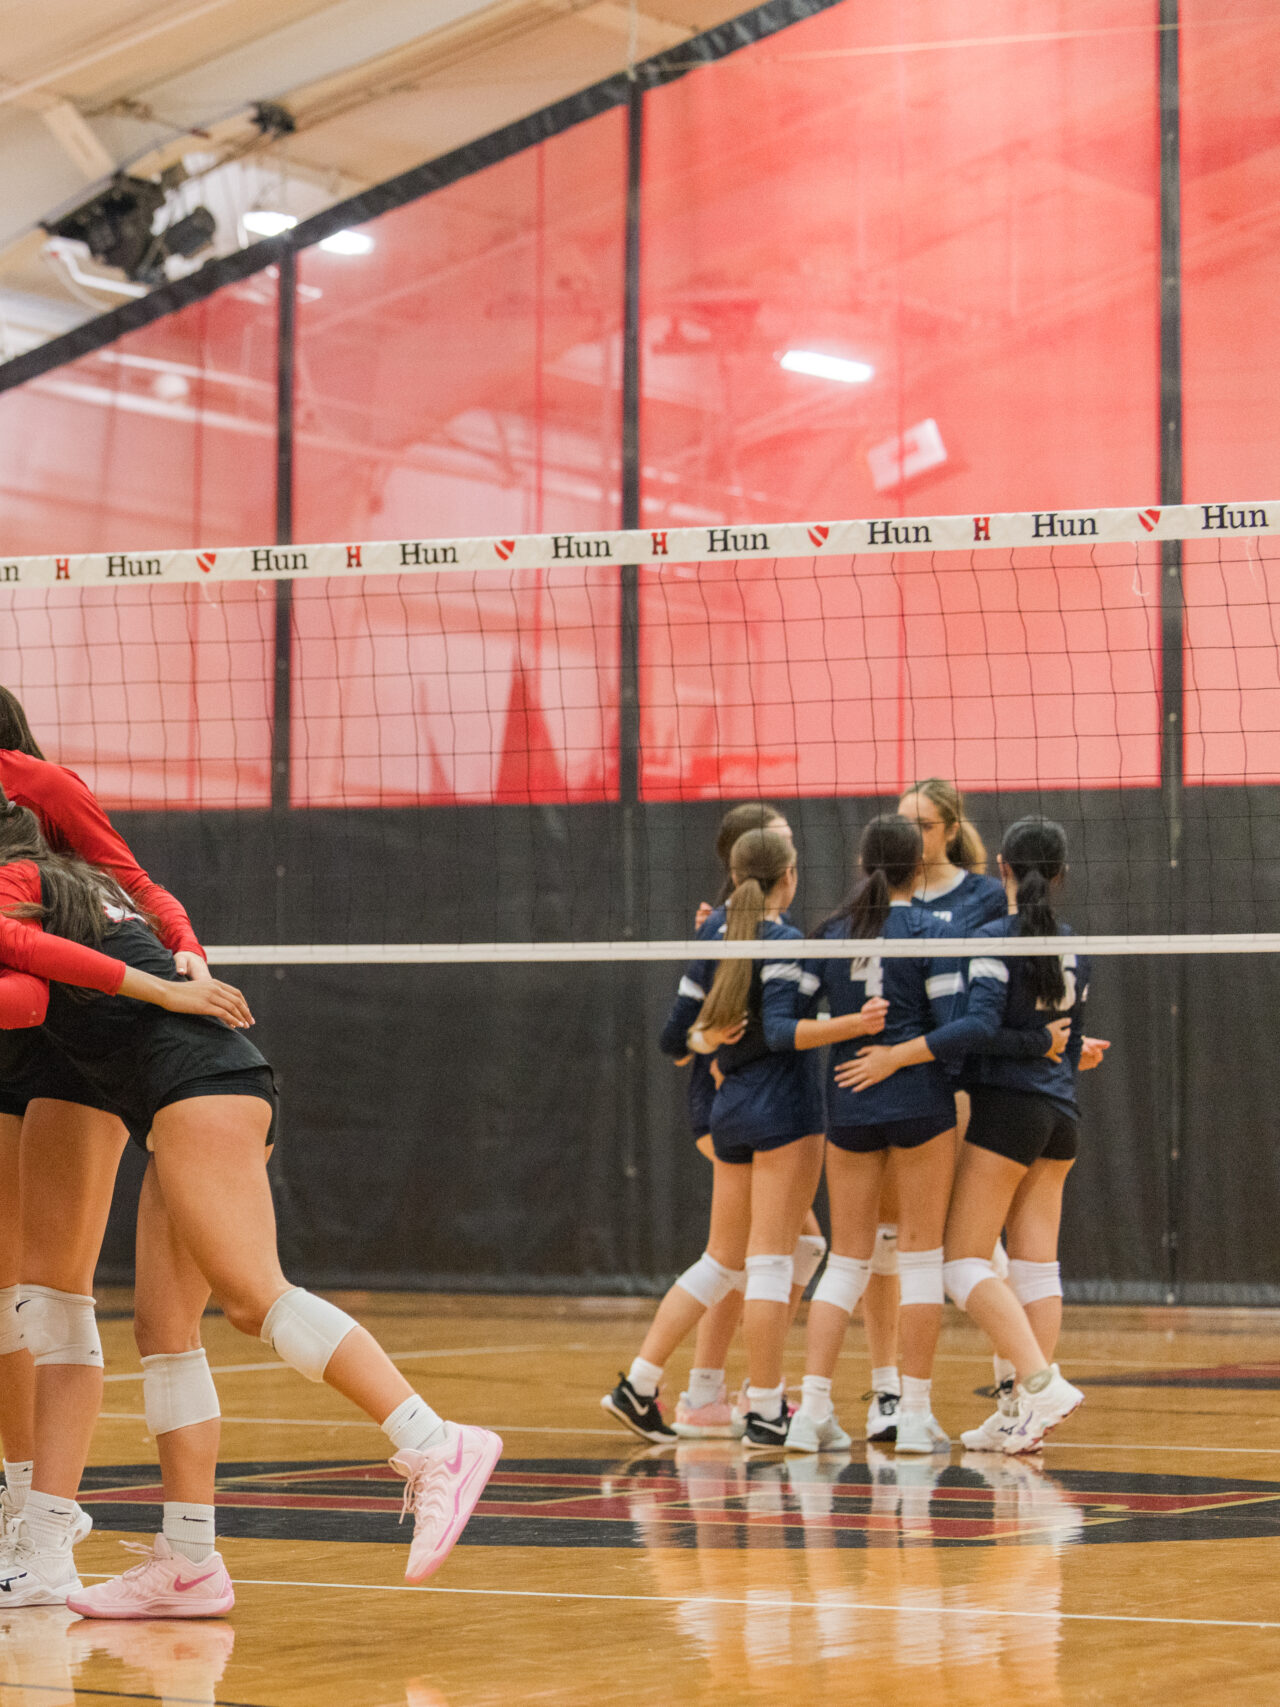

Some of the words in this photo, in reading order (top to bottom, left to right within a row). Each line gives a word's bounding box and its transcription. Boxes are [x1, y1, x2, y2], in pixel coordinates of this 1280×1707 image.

[55, 558, 71, 580] H
[107, 555, 162, 577] Hun
[252, 549, 308, 572] Hun
[346, 545, 362, 568] H
[400, 543, 458, 566] Hun
[552, 535, 612, 559] Hun
[651, 532, 669, 556] H
[707, 529, 769, 553] Hun
[867, 521, 932, 545] Hun
[973, 516, 991, 542] H
[1031, 513, 1099, 538] Hun
[1201, 504, 1269, 530] Hun
